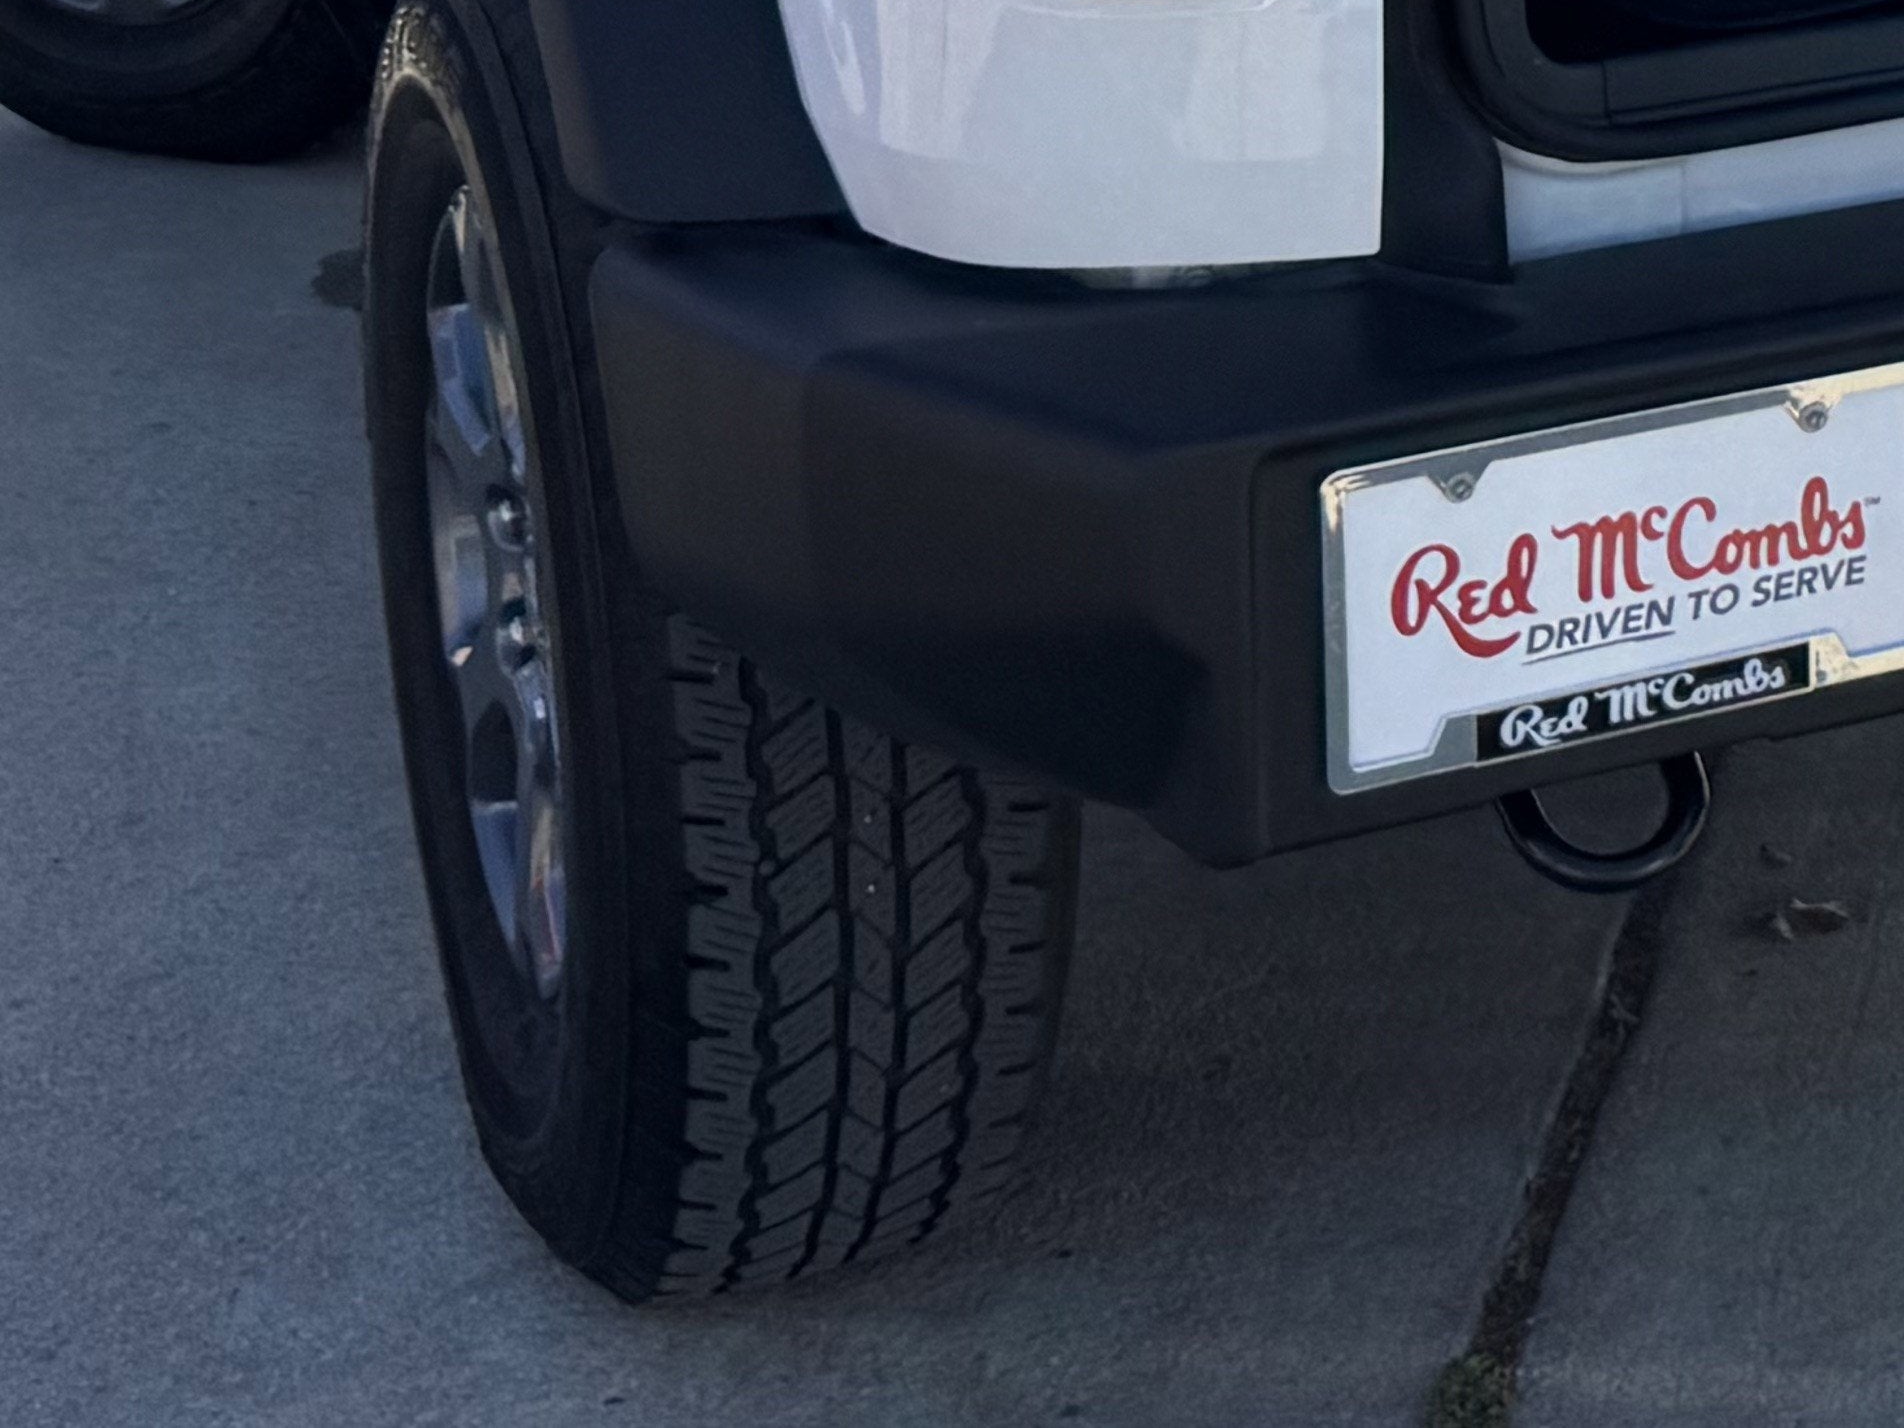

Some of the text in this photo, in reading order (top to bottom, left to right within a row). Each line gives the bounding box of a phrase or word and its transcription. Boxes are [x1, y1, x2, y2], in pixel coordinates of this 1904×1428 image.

[1391, 476, 1867, 658] Red McCombs
[1526, 555, 1868, 655] DRIVEN TO SERVE
[1501, 658, 1786, 746] Red McCombs
